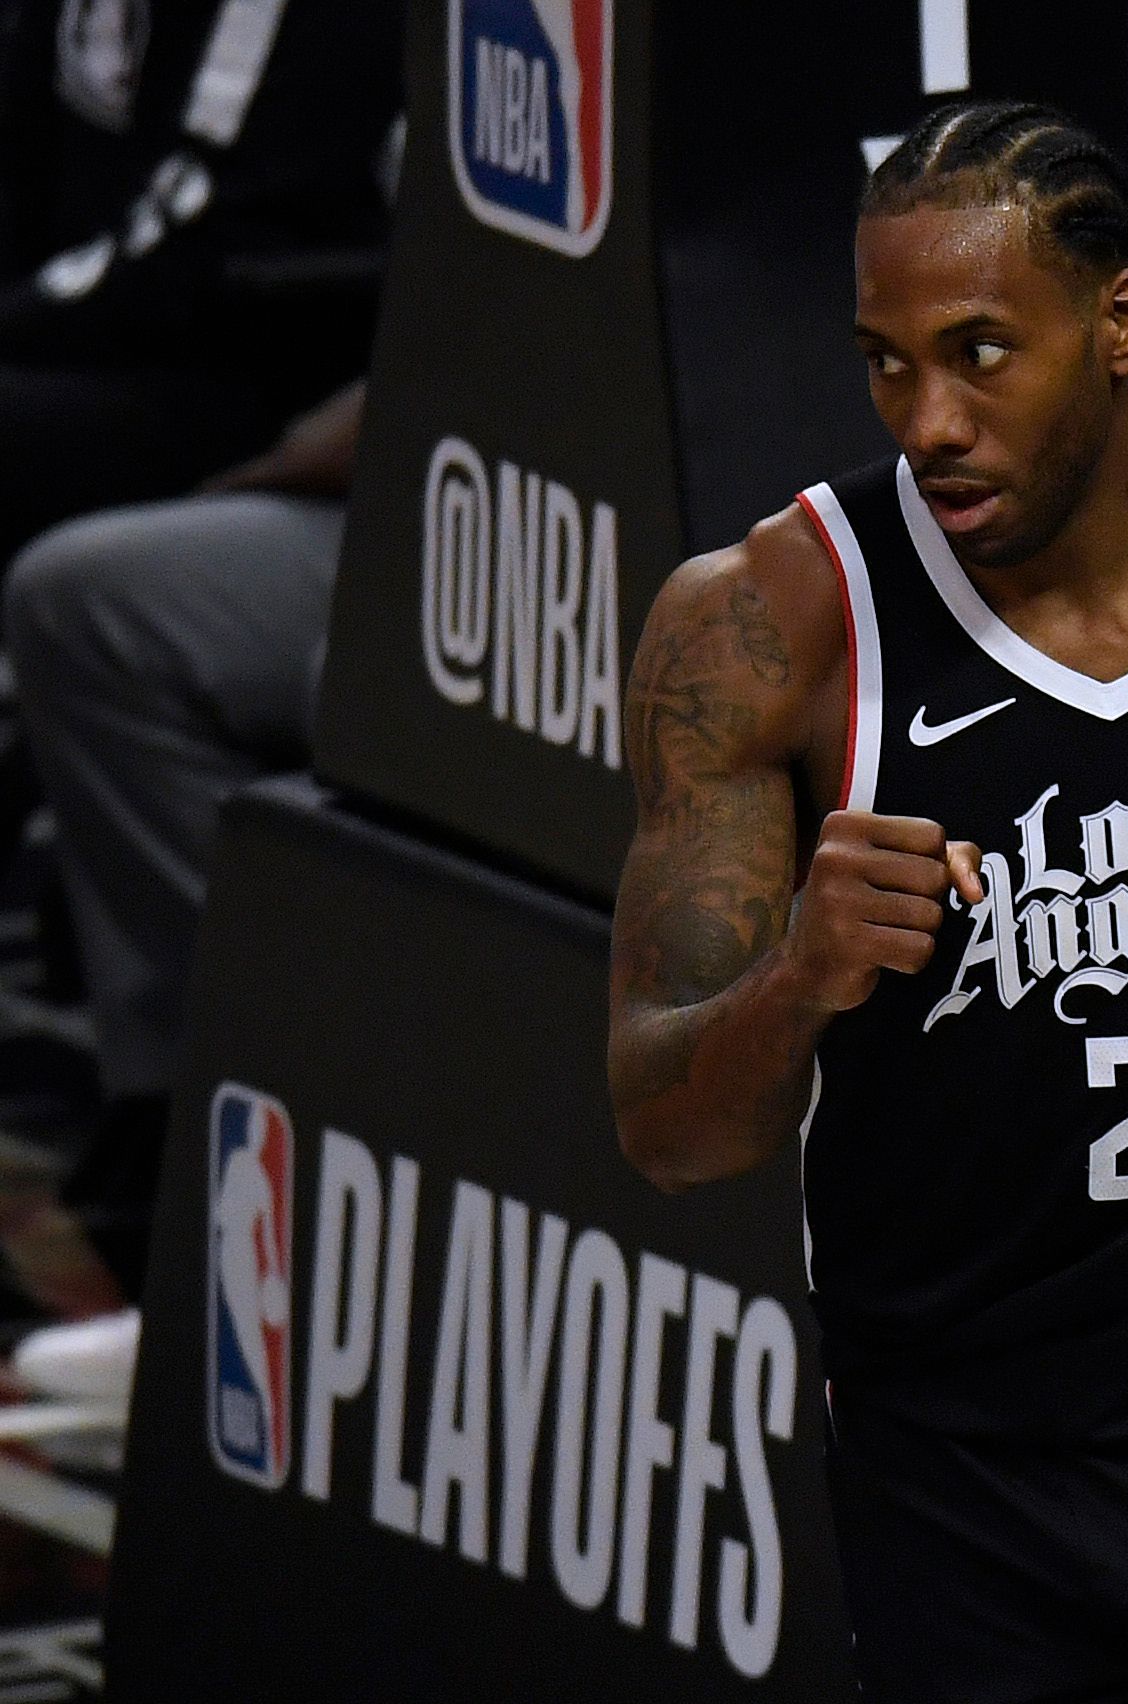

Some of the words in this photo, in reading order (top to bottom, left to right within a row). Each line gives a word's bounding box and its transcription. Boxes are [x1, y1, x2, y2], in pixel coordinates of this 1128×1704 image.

[475, 36, 552, 184] NBA
[421, 436, 622, 769] @NBA
[302, 1128, 798, 1680] PLAYOFFS
